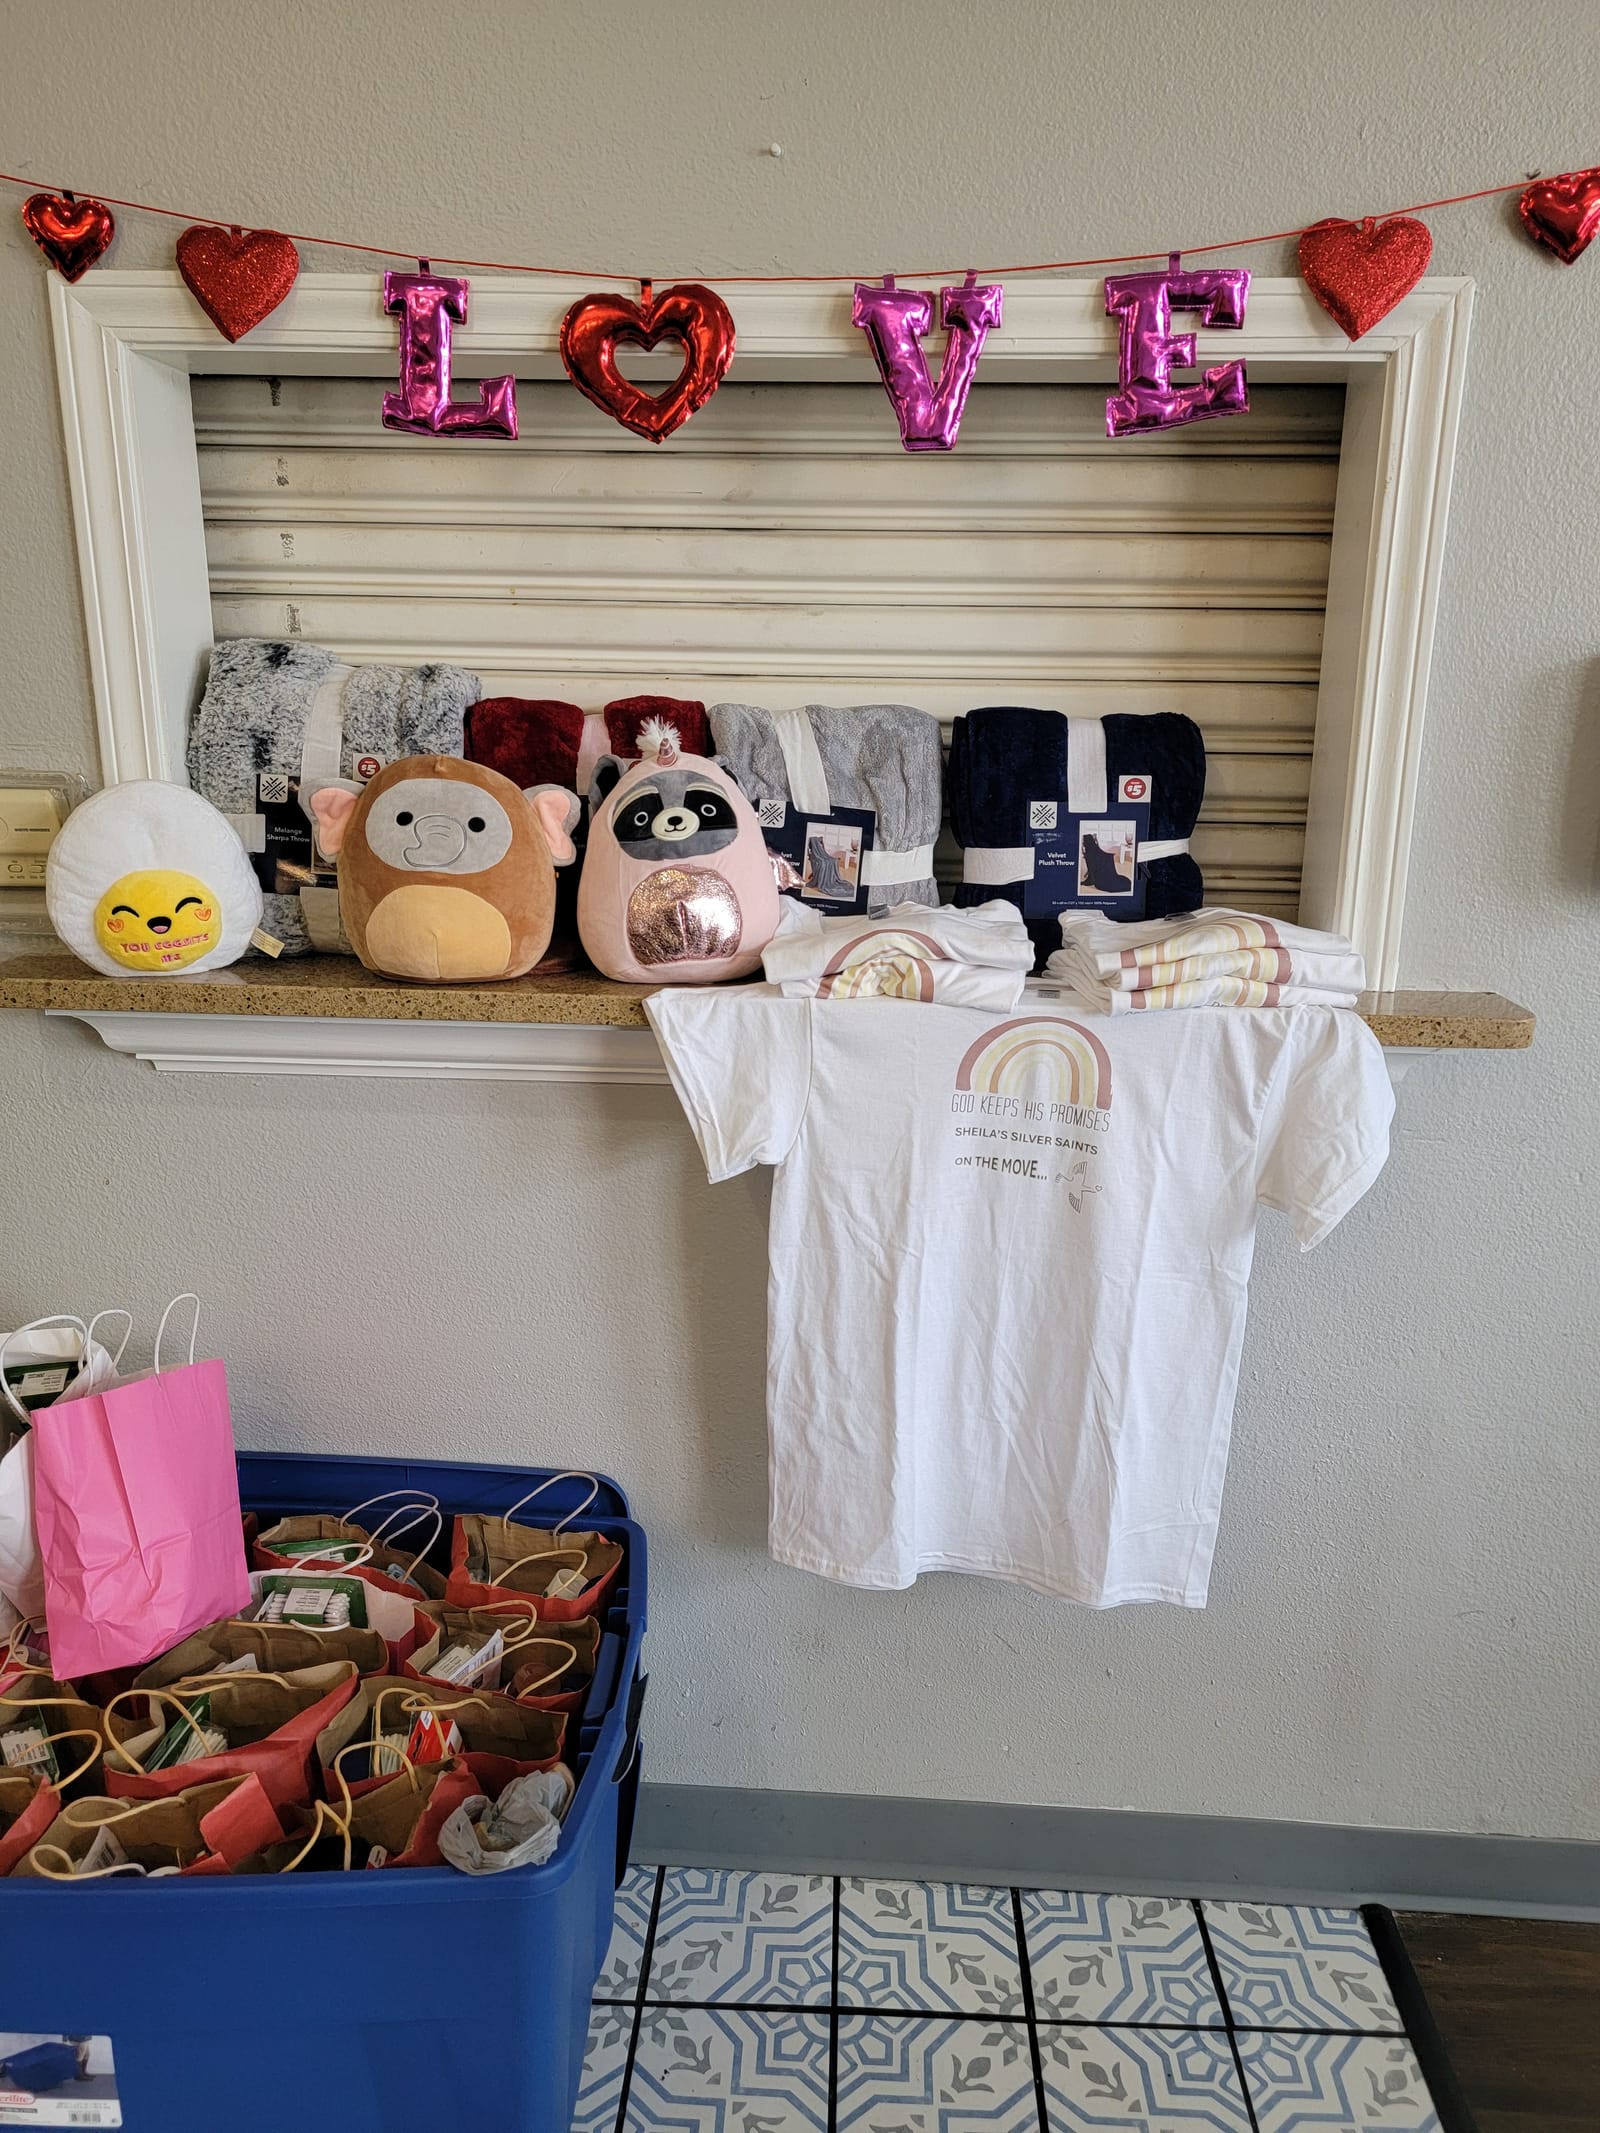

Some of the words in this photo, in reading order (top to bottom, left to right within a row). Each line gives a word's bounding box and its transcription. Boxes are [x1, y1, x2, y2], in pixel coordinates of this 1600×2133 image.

[266, 834, 290, 842] Sherpa
[1047, 852, 1067, 860] Velvet
[120, 942, 150, 953] YOU
[951, 1093, 975, 1113] GOD
[980, 1095, 1020, 1118] KEEPS
[1024, 1101, 1044, 1121] HIS
[1049, 1103, 1111, 1133] PROMISES
[955, 1127, 1008, 1140] SHEILA'S
[1010, 1131, 1052, 1146] SILVER
[1054, 1137, 1098, 1155] SAINTS
[954, 1157, 972, 1166] ON
[975, 1156, 999, 1171] THE
[1001, 1158, 1047, 1181] MOVE...
